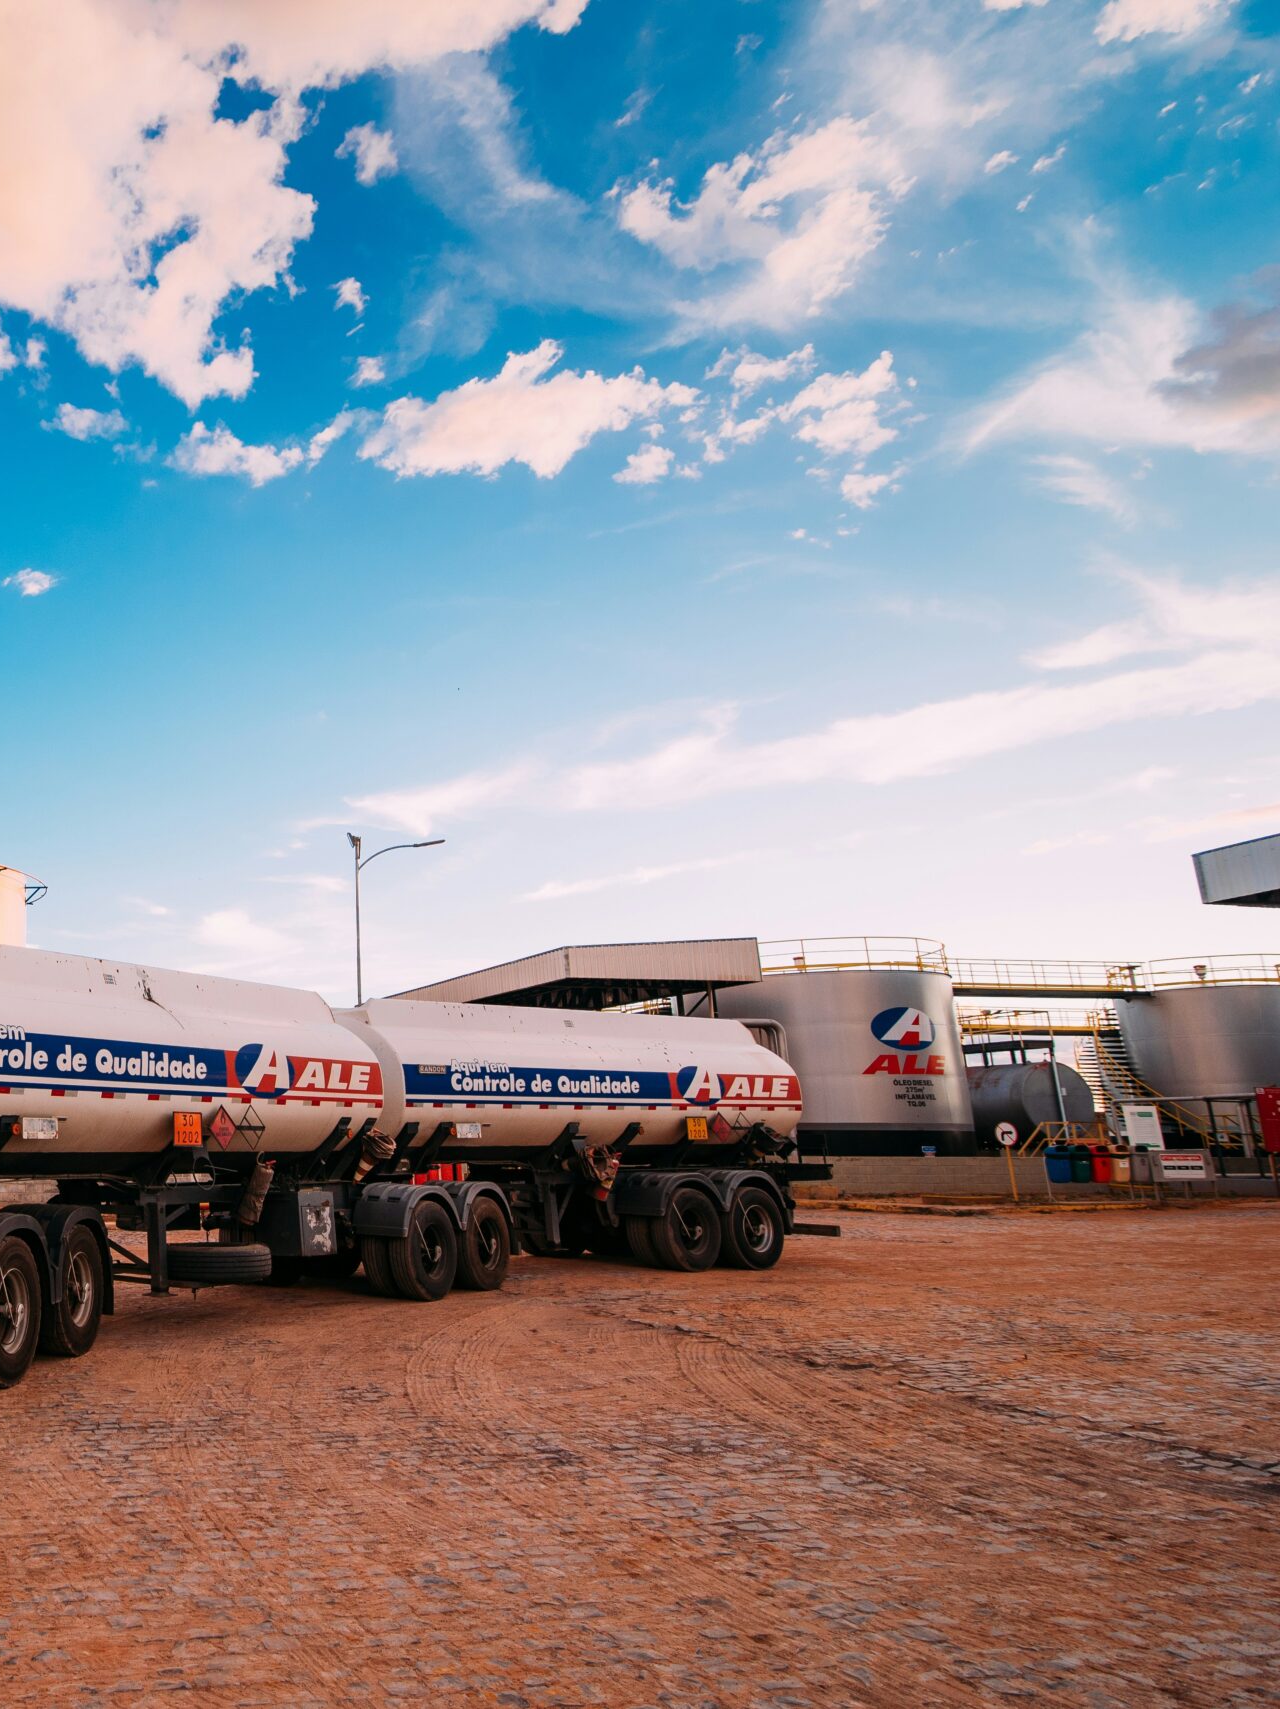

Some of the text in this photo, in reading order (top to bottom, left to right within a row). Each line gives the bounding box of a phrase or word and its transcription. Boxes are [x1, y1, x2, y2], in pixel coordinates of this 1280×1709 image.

[56, 1044, 87, 1072] de
[95, 1049, 207, 1080] Qualidade
[450, 1058, 510, 1076] Aqui tem
[862, 1054, 945, 1075] ALE
[295, 1061, 371, 1091] ALE
[451, 1073, 640, 1094] Controle de Qualidade
[893, 1078, 912, 1086] ÓLEO
[726, 1077, 789, 1098] ALE
[182, 1114, 194, 1127] 30
[177, 1131, 199, 1144] 1202
[689, 1129, 707, 1139] 1202
